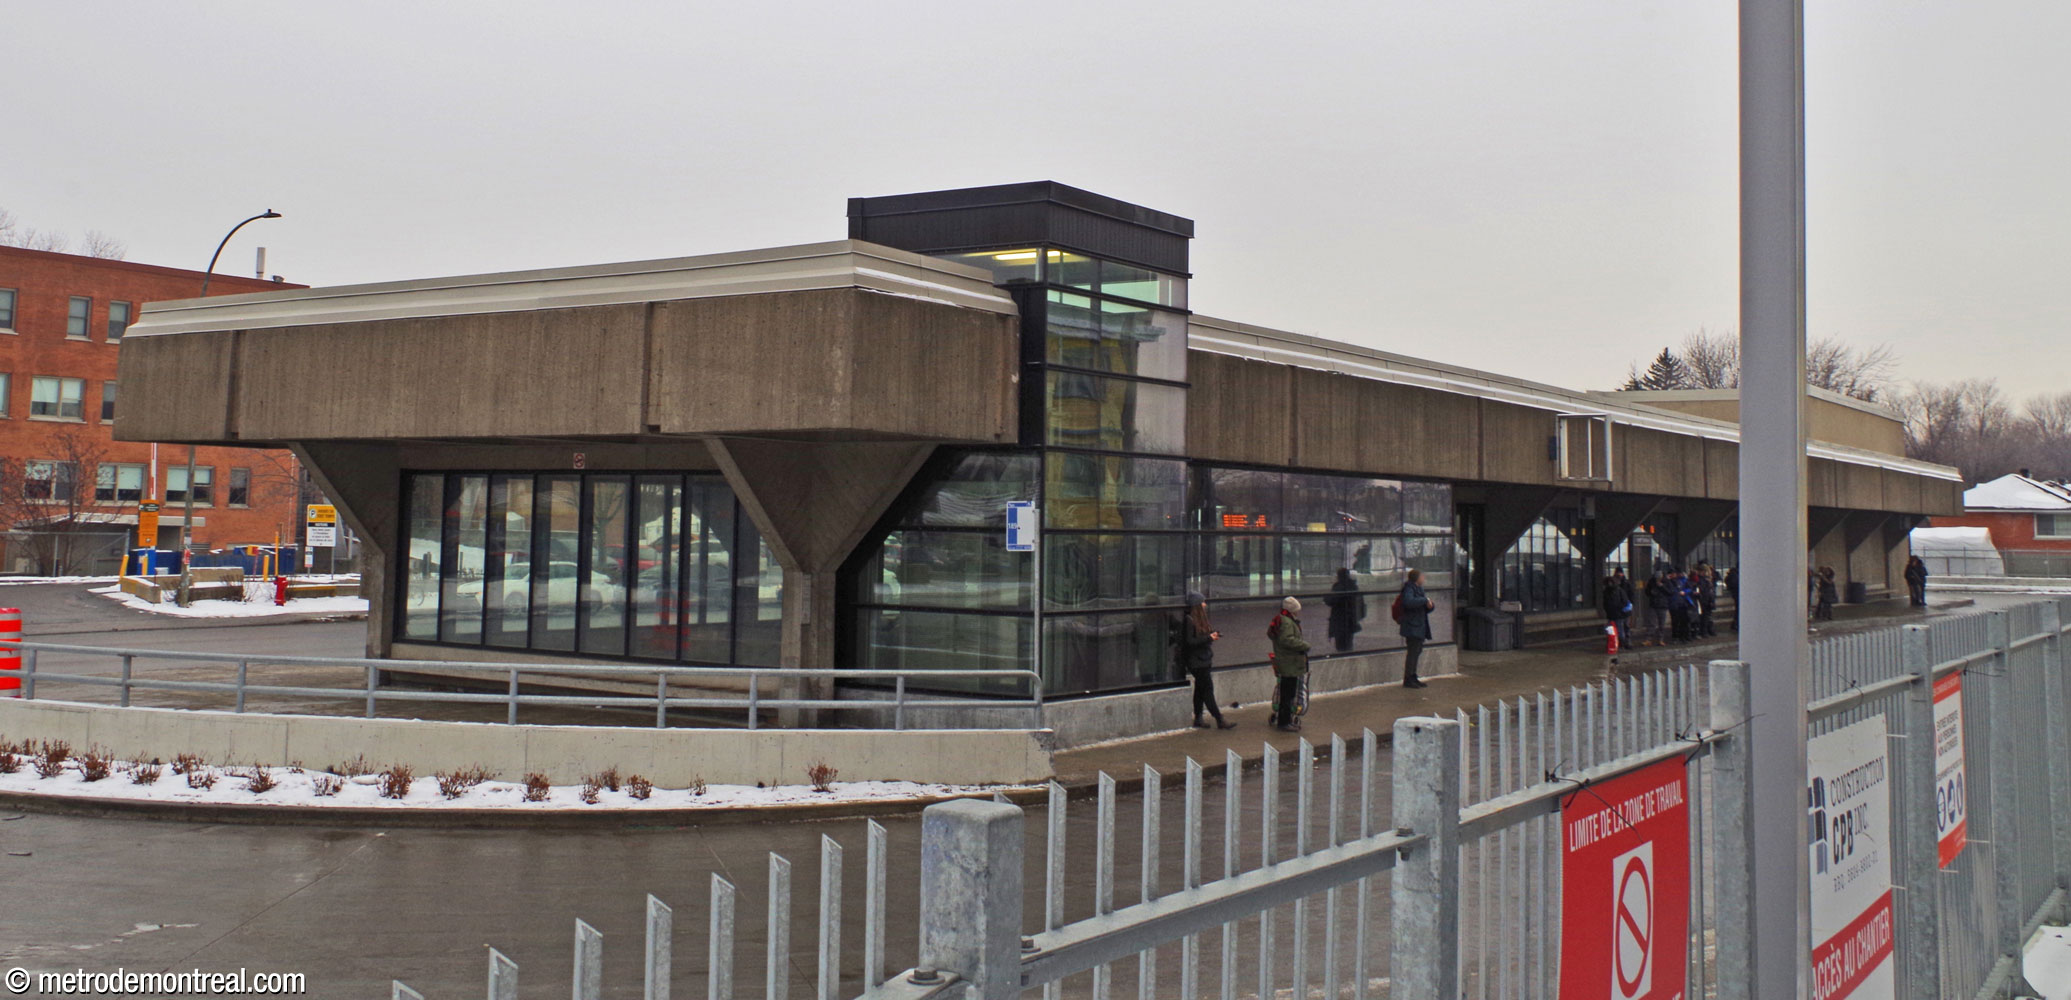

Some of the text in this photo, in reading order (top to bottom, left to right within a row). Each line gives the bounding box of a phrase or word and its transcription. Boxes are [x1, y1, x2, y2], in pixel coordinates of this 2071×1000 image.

[1830, 756, 1884, 807] CONSTRUCTION
[1570, 780, 1683, 852] LIMITE DE LA ZONE DE TRAVAIL
[1832, 809, 1854, 865] CPB
[1843, 936, 1856, 983] AU
[1857, 907, 1890, 970] CHANTIER
